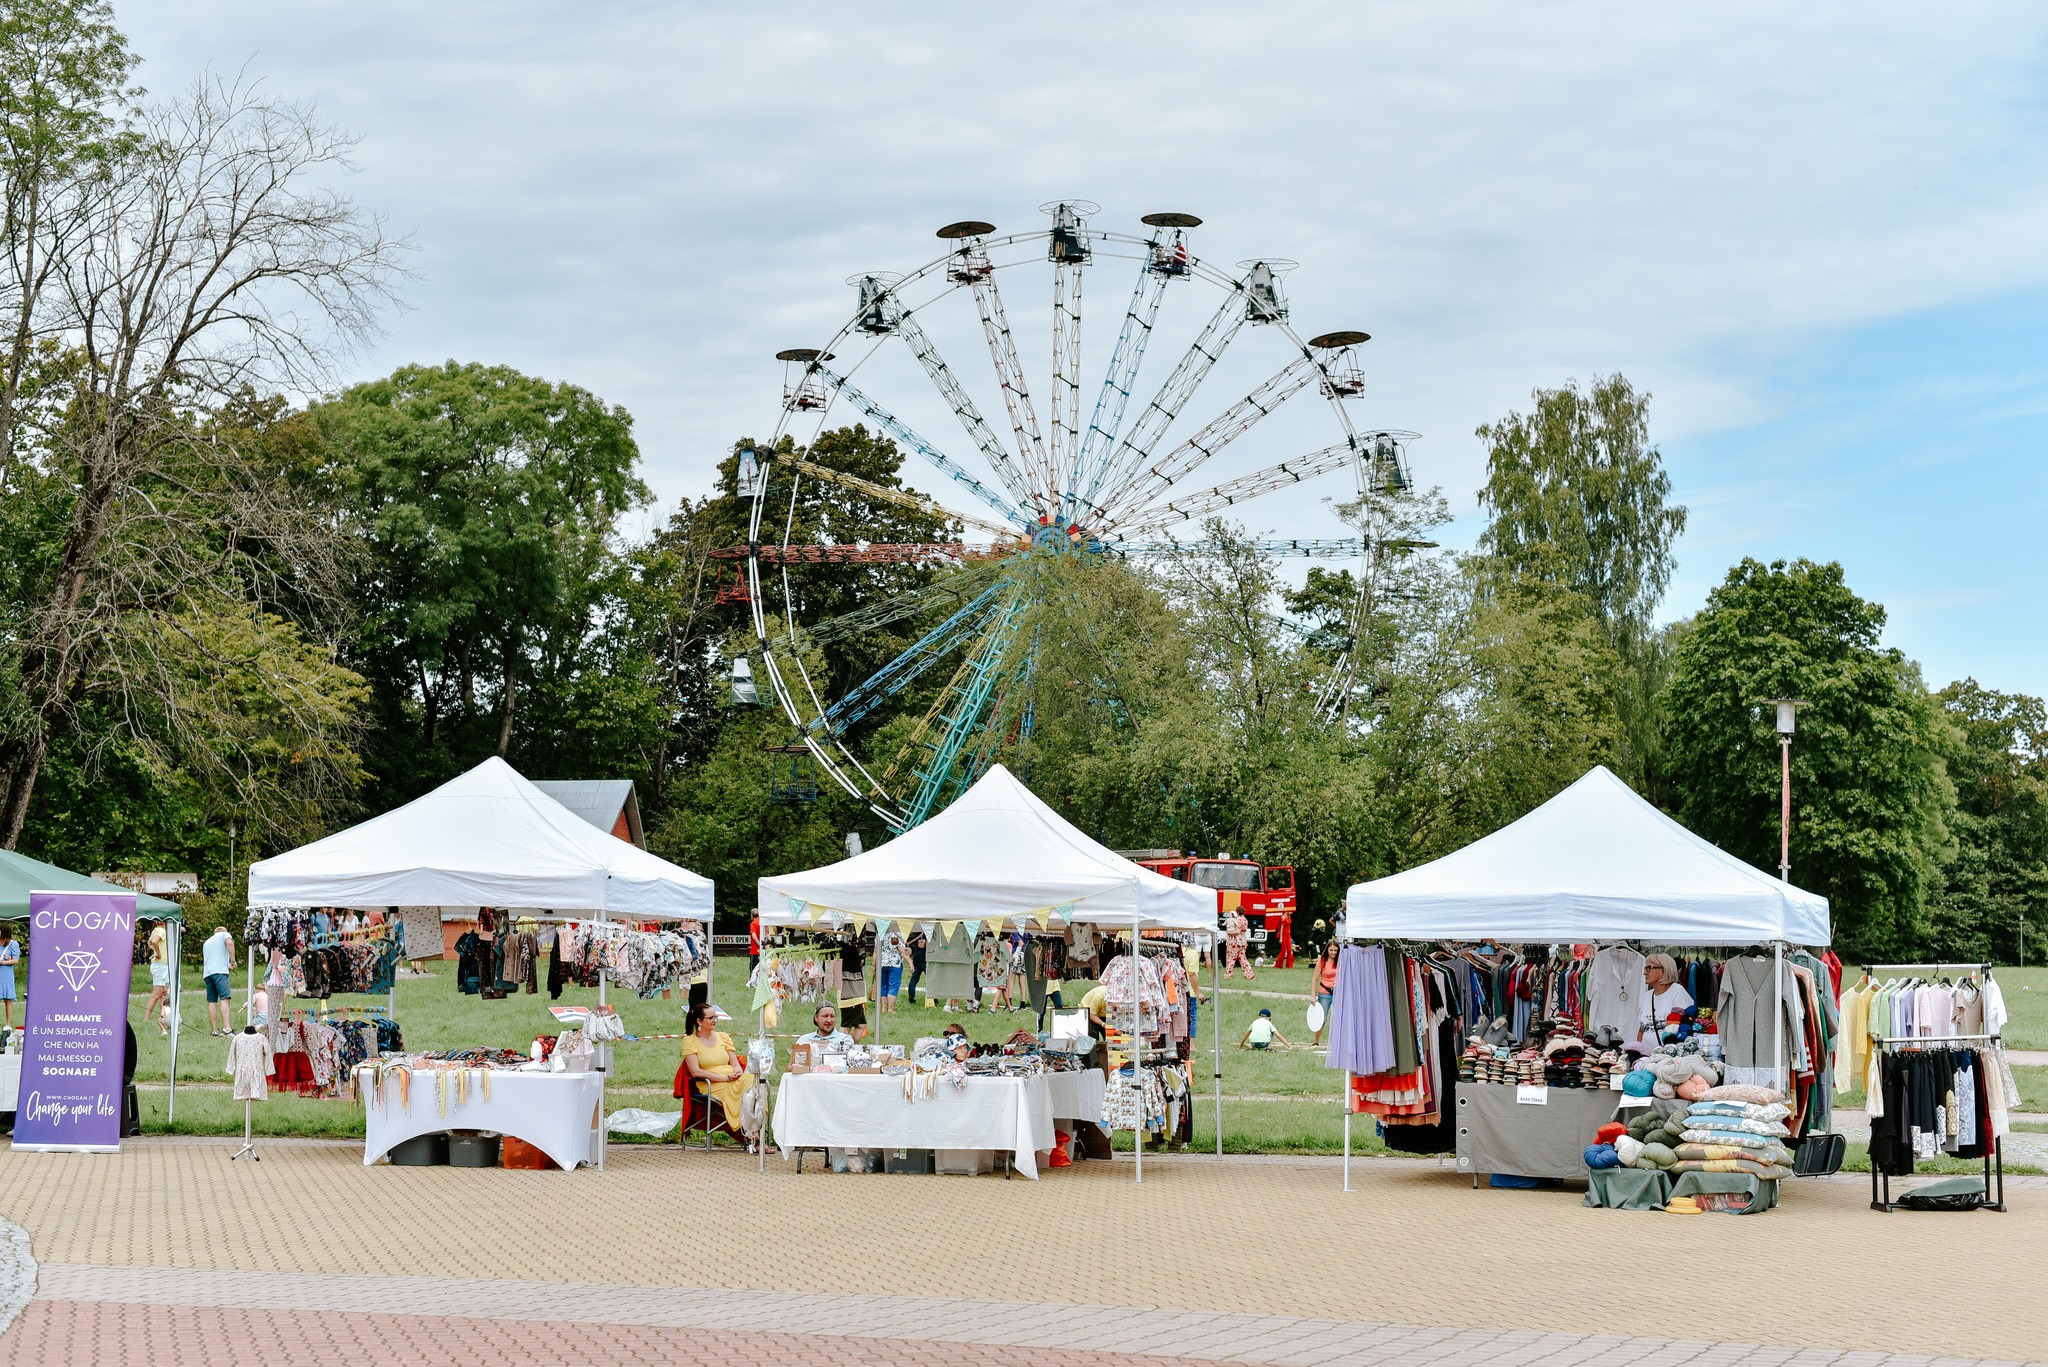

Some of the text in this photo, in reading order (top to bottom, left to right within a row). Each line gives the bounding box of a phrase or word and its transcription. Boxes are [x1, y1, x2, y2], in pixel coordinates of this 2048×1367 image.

[35, 910, 131, 931] CHOGAN
[45, 1014, 102, 1022] IL DIAMANTE
[40, 1027, 54, 1035] UN
[55, 1027, 98, 1036] SEMPLICE
[43, 1040, 100, 1050] CHE NON HA
[38, 1054, 103, 1063] MAI SMESSO DI
[42, 1067, 97, 1076] SOGNARE
[26, 1090, 116, 1127] Change your life
